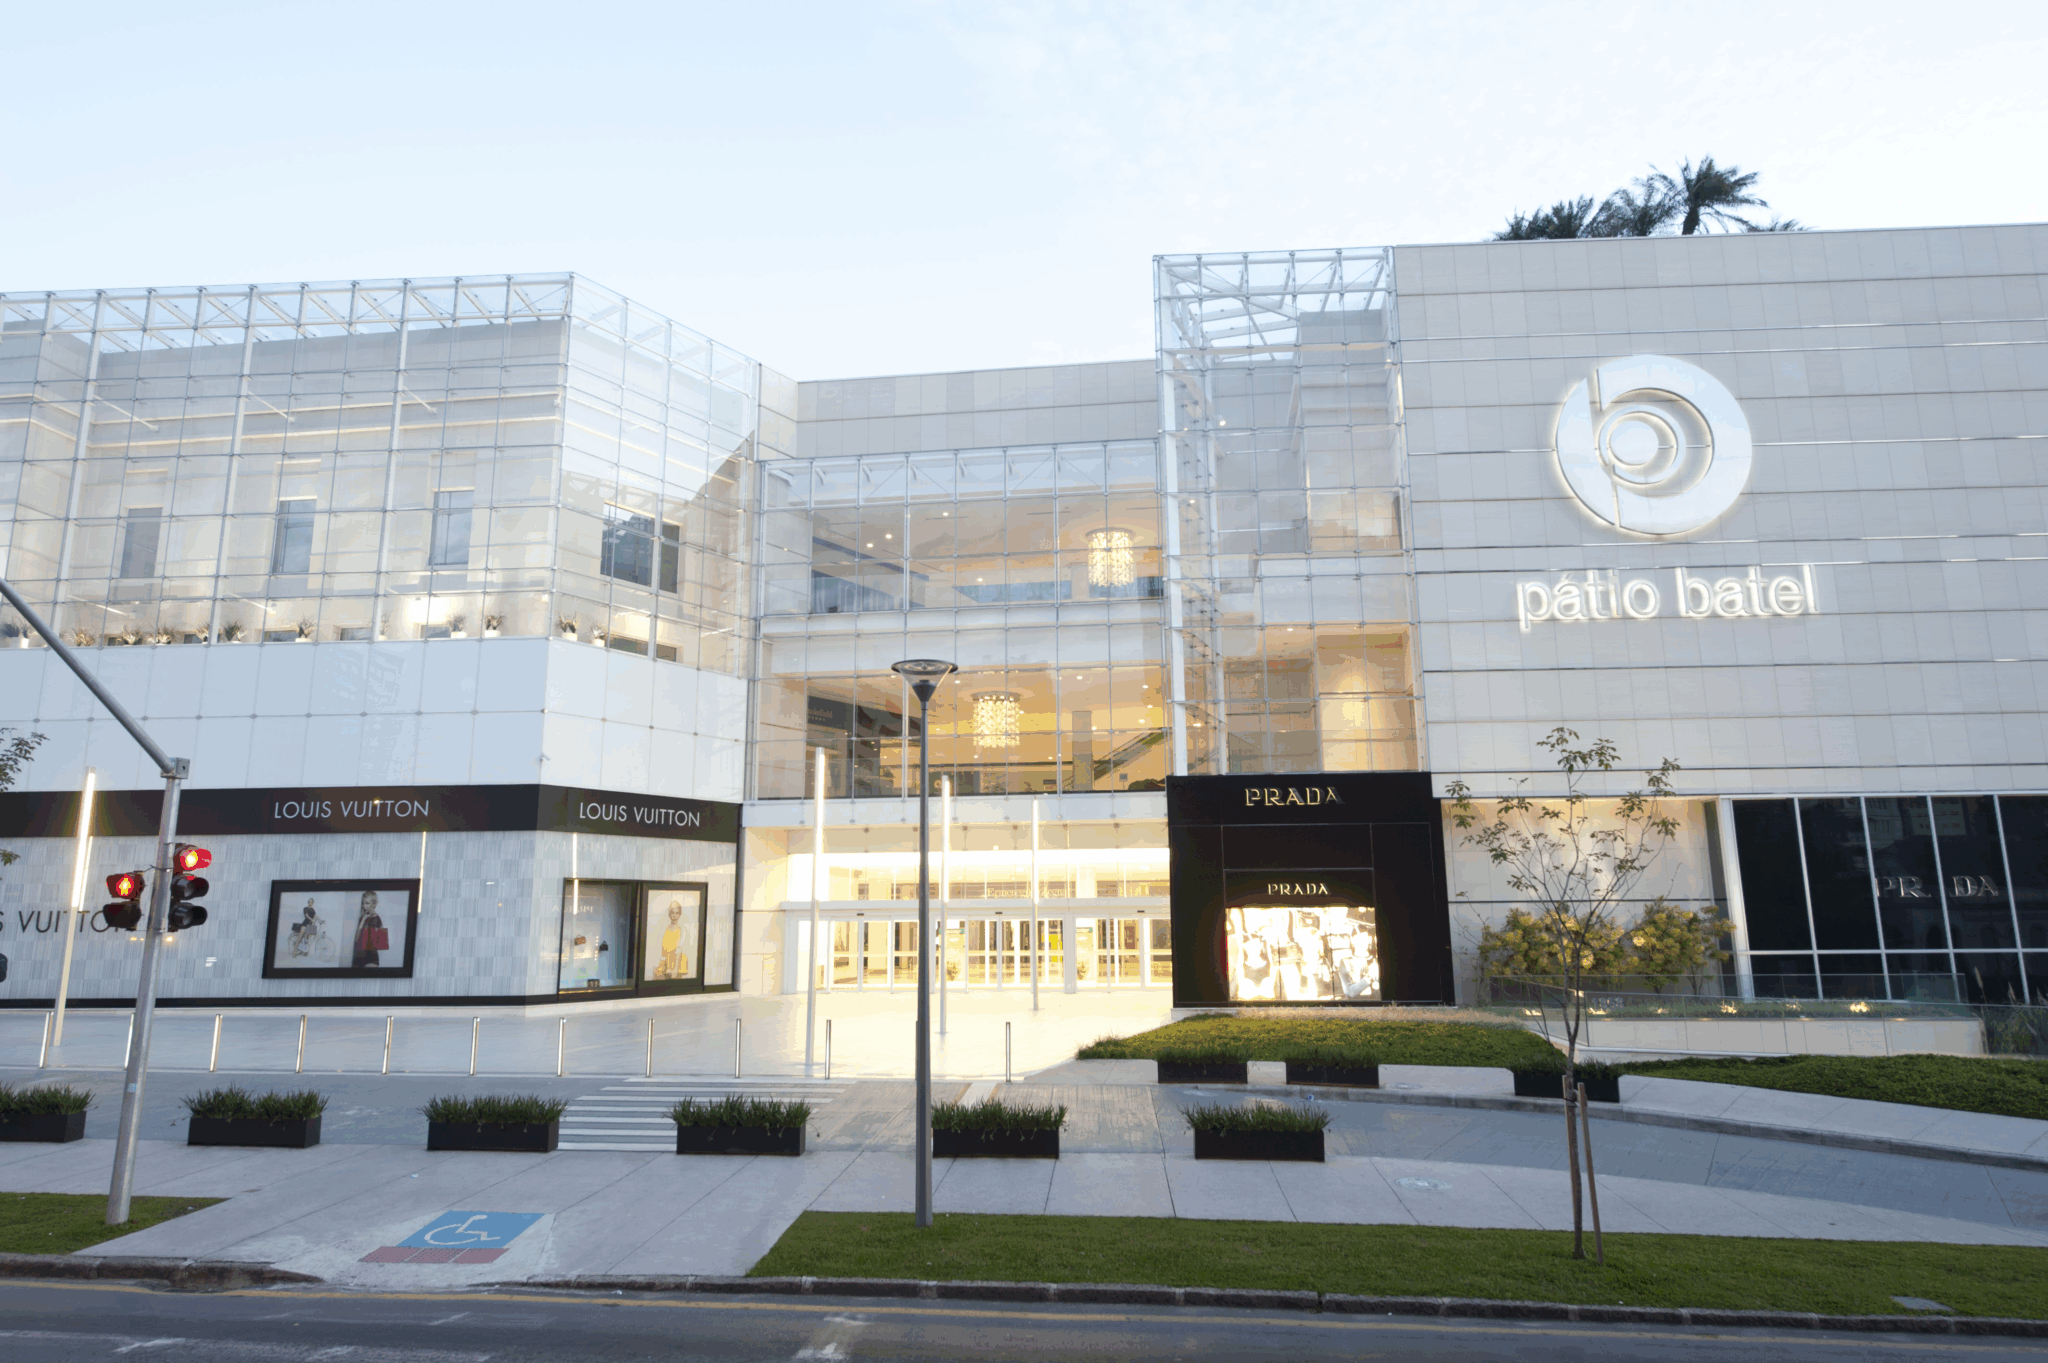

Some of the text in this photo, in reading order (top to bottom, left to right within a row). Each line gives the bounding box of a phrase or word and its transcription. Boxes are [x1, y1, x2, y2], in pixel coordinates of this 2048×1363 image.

[1517, 563, 1820, 632] pátio batel
[1245, 786, 1346, 806] PRADA
[274, 800, 430, 819] LOUIS VUITTON
[579, 802, 700, 827] LOUIS VUITTON
[1267, 883, 1331, 895] PRADA
[1875, 875, 1999, 898] PRDA
[18, 910, 119, 933] VUITO
